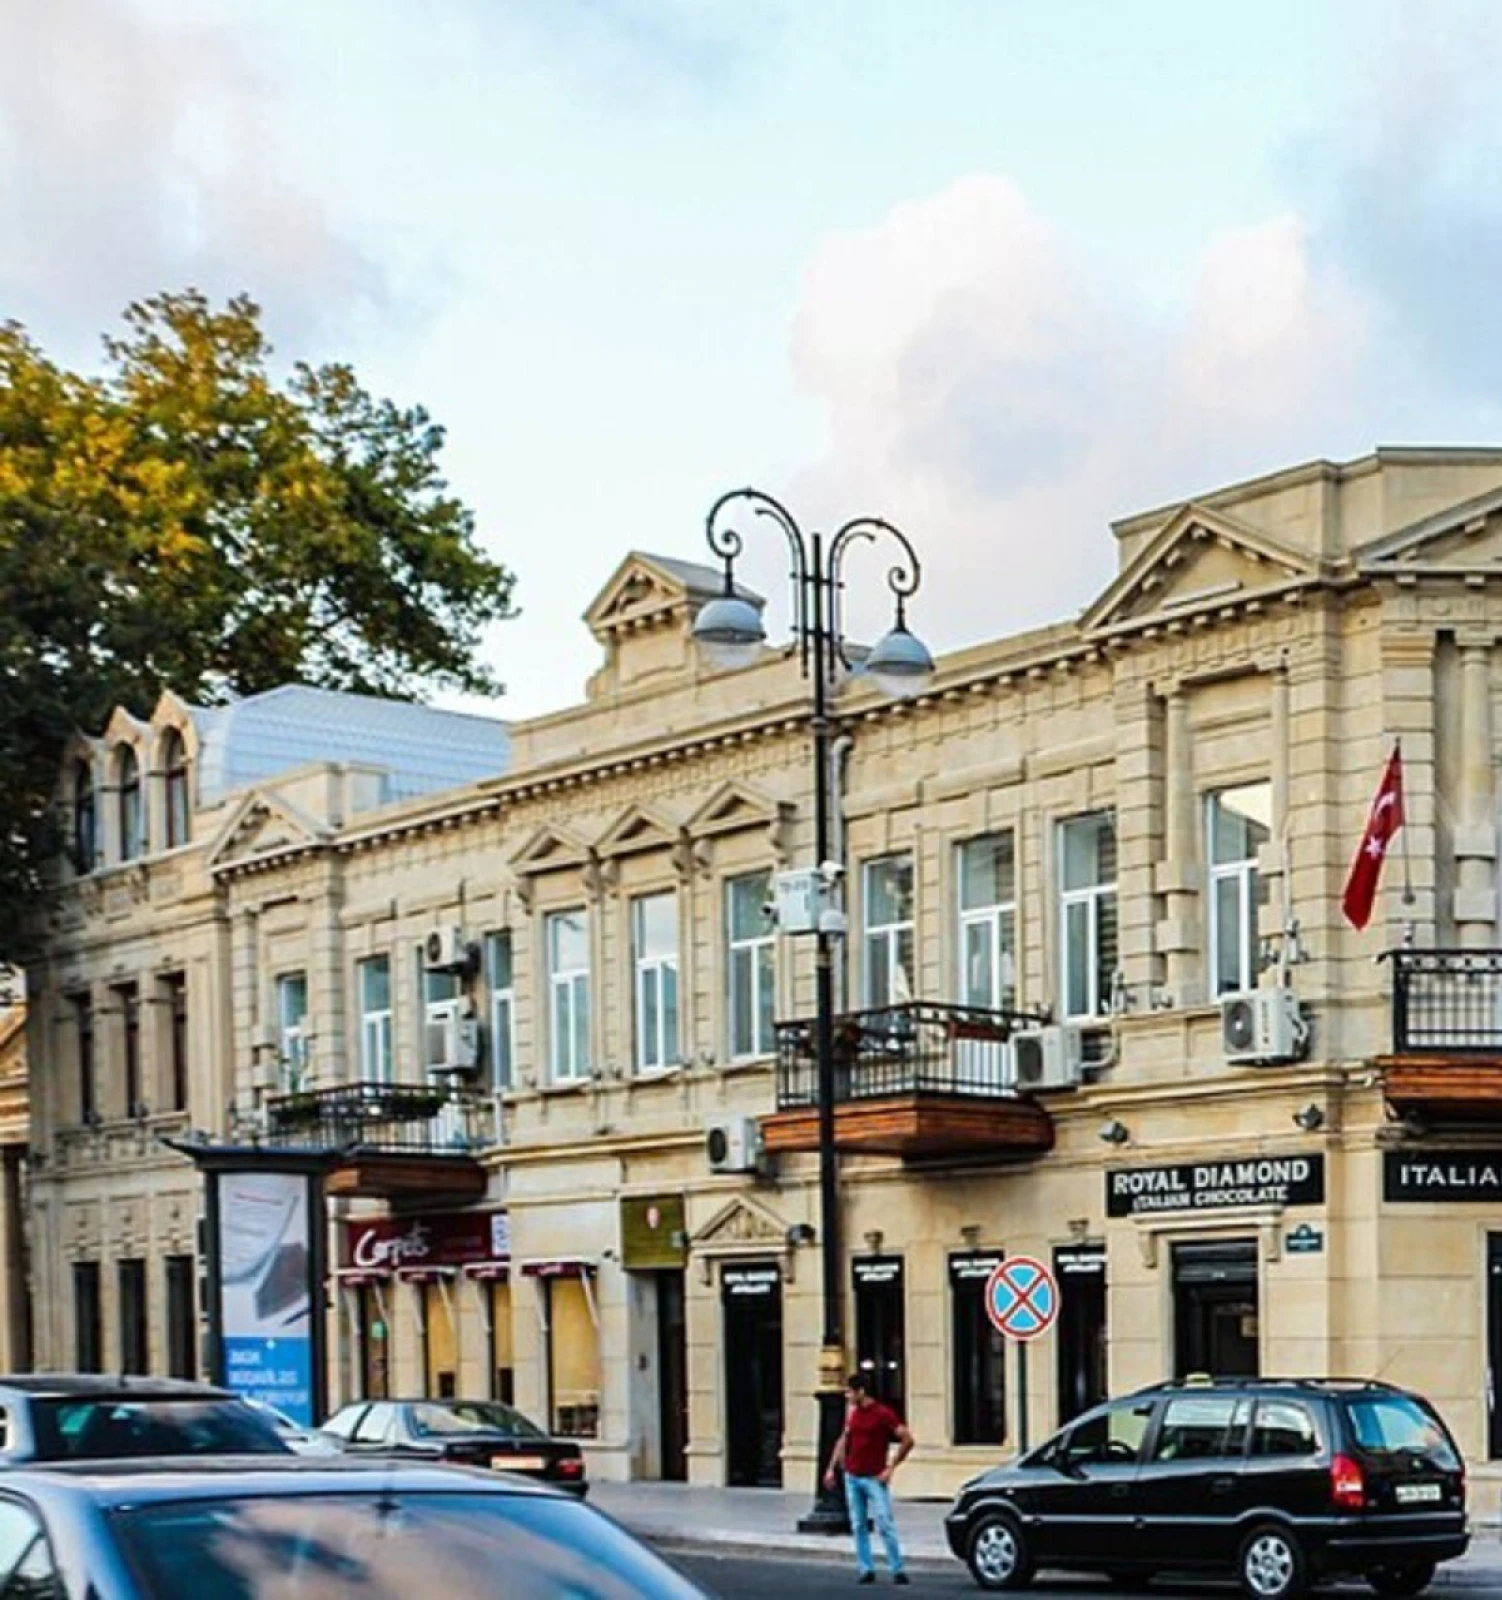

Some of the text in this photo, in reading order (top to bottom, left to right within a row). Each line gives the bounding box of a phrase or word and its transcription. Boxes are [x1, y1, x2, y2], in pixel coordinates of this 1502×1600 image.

[1113, 1160, 1309, 1194] ROYAL DIAMOND
[1132, 1186, 1289, 1211] ITALIAN CHOCOLATE
